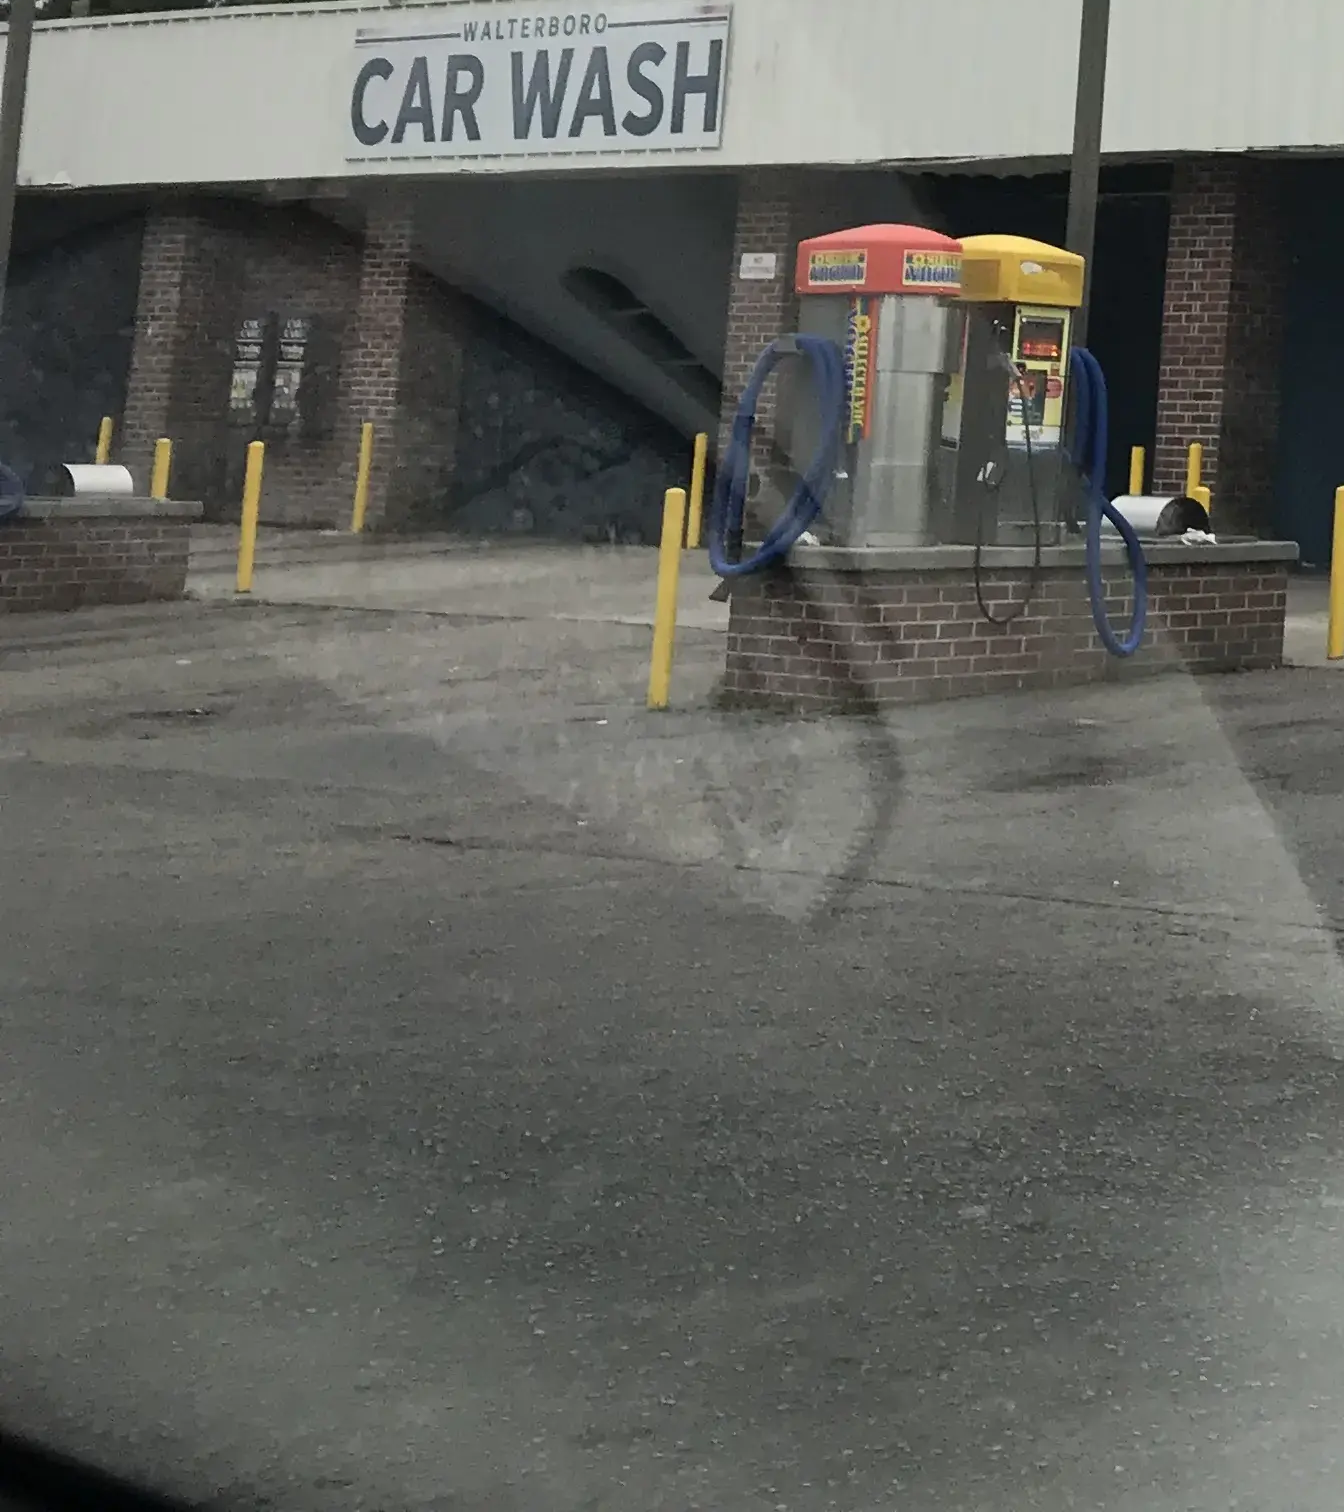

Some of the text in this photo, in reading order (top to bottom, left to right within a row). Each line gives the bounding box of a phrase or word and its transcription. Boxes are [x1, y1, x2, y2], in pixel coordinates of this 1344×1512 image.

[463, 12, 609, 43] WALTERBORO
[351, 39, 723, 146] CAR WASH
